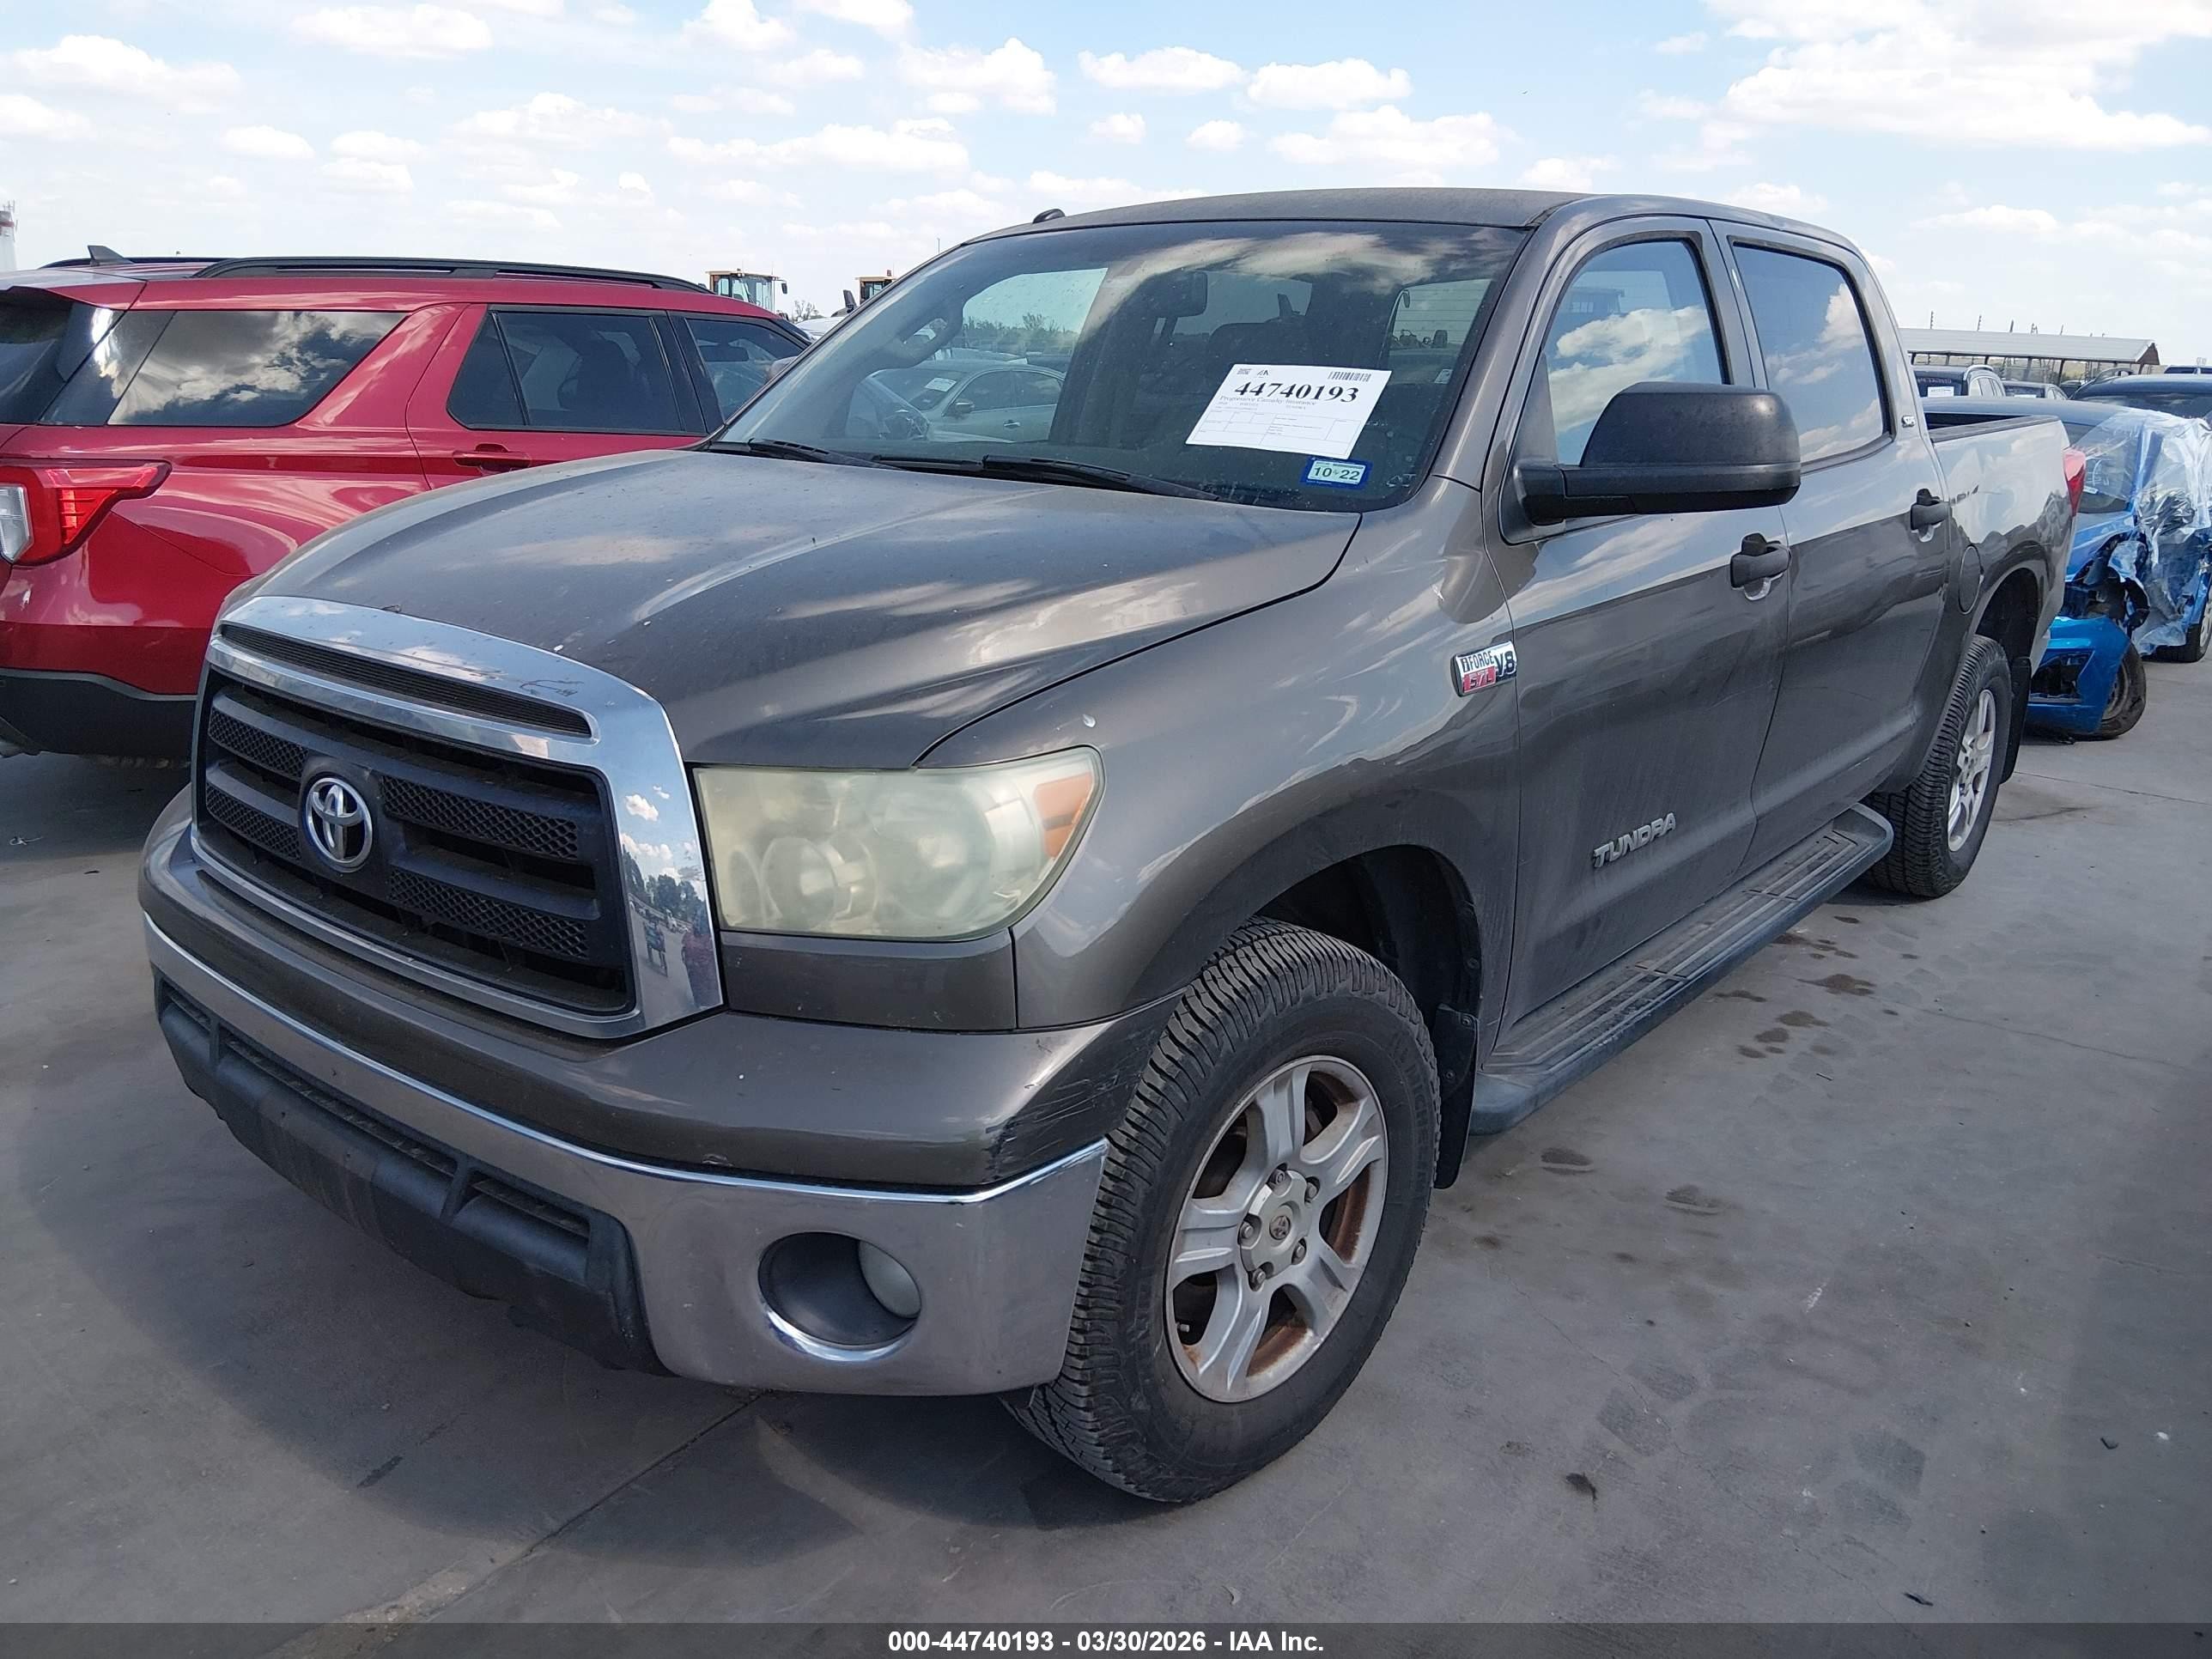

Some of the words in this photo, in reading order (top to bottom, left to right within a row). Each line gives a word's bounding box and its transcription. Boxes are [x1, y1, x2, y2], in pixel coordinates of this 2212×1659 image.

[1235, 381, 1359, 403] 44740193
[1315, 467, 1333, 477] 10
[1340, 469, 1360, 480] 22
[1494, 651, 1516, 677] V8
[1593, 812, 1676, 868] TUNDRA
